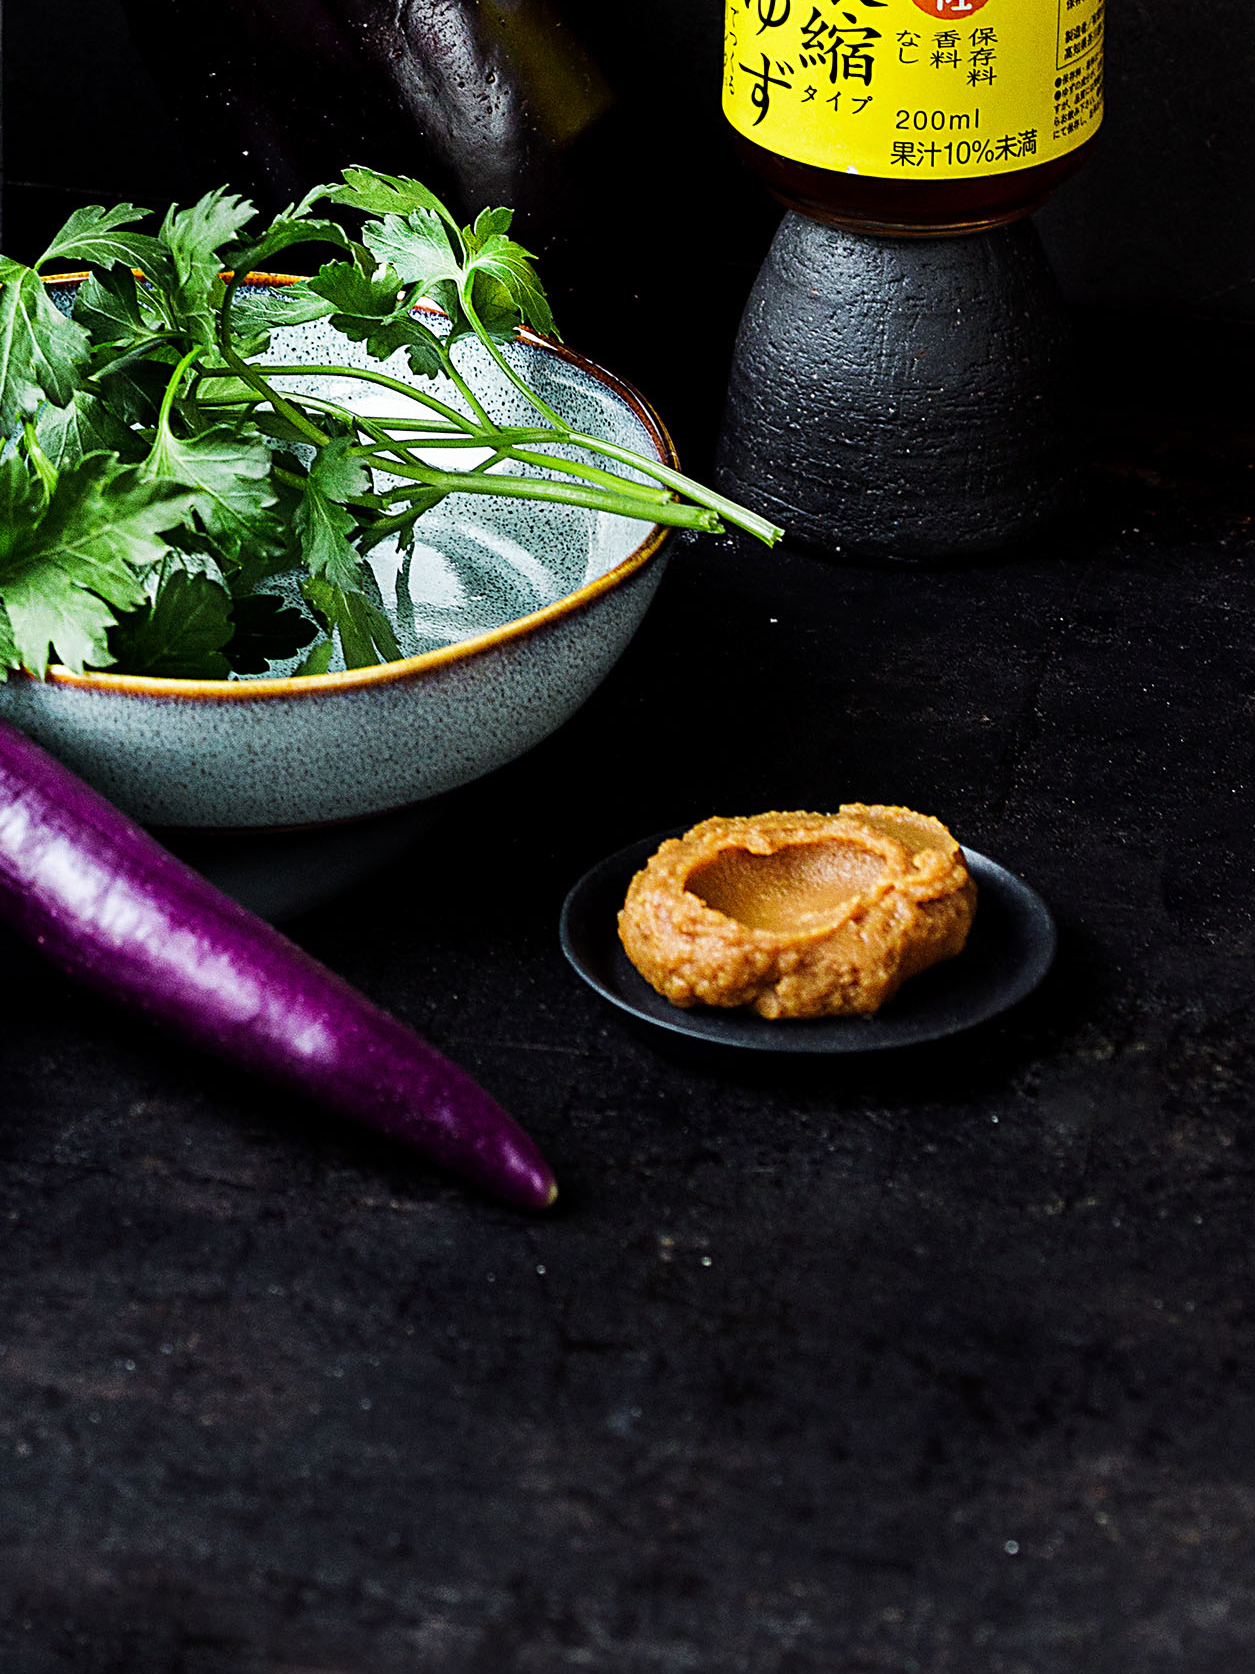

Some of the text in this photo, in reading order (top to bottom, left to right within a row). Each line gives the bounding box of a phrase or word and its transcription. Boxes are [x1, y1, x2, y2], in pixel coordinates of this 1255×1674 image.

[895, 27, 999, 87] 保存料 香料 なし
[894, 108, 981, 132] 200ml
[889, 128, 1039, 168] 果汁10%未満
